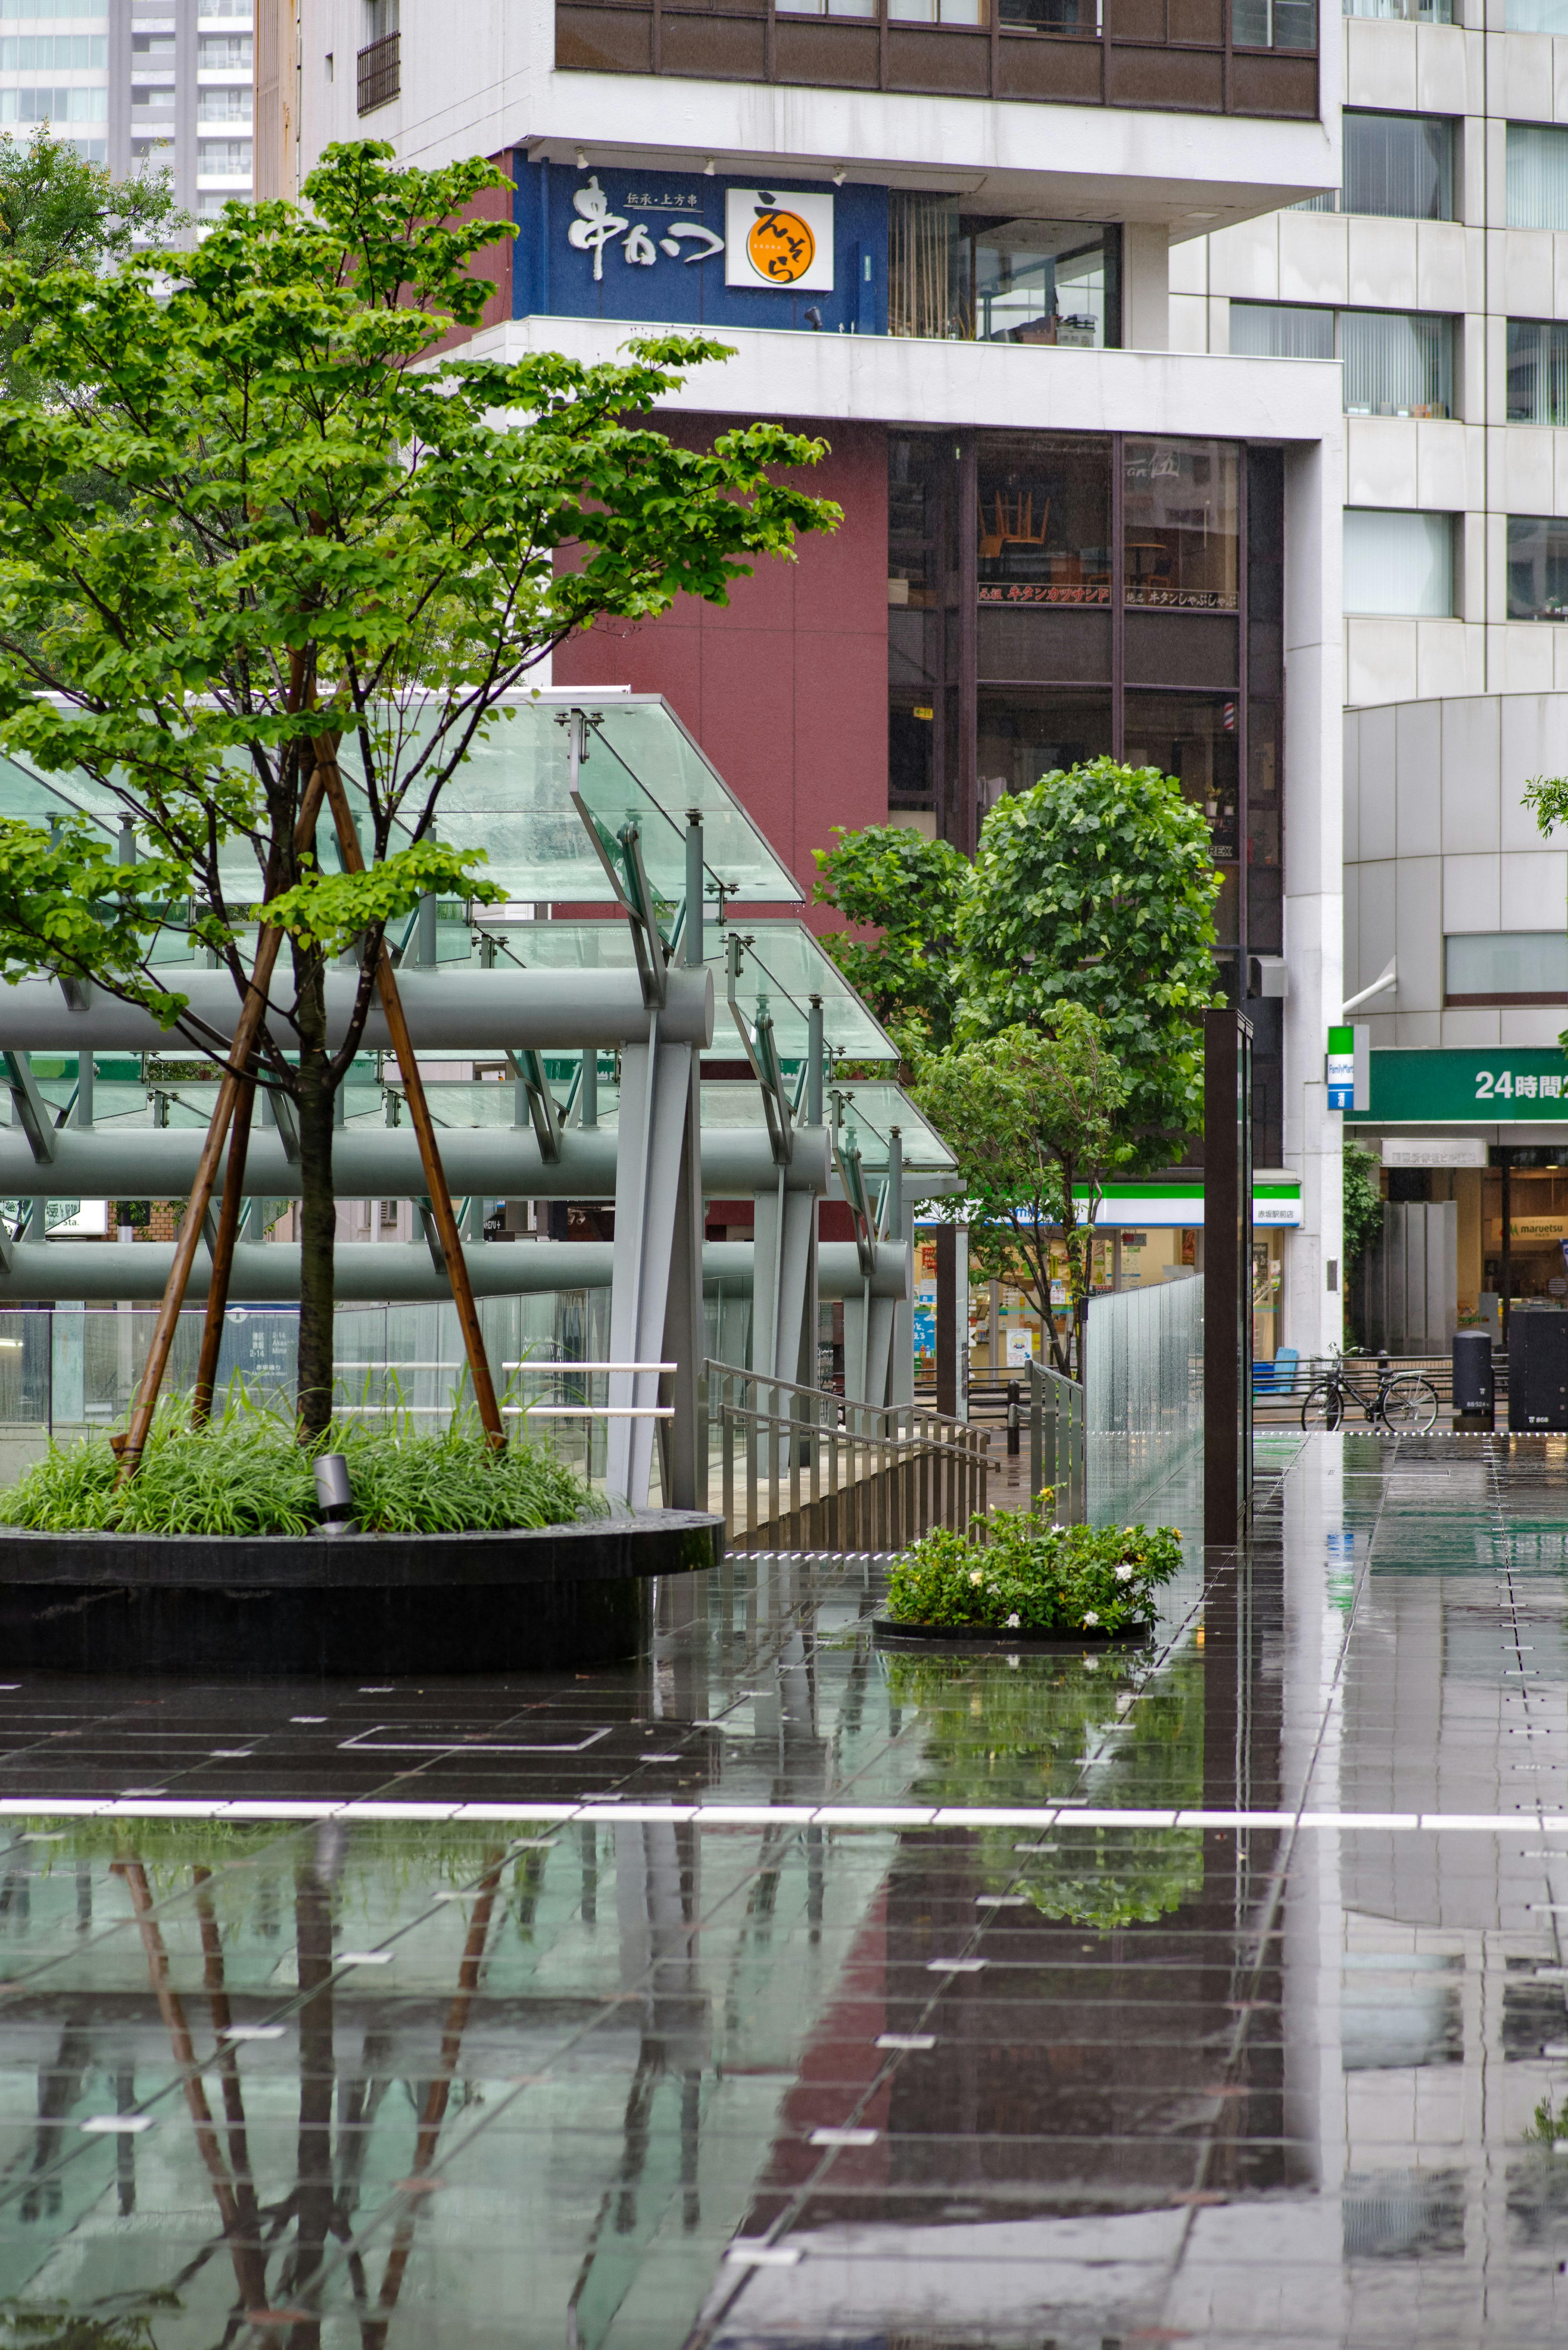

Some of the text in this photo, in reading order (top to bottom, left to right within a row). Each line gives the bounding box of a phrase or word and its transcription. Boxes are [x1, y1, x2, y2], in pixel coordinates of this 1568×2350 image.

[626, 192, 698, 207] 伝承・上方串
[568, 176, 725, 281] 串かつ
[979, 585, 1109, 603] 元祖 牛タンカツサンド
[1127, 591, 1236, 607] 絶品 牛タンしゃぶしゃぶ
[1205, 845, 1232, 857] REX
[1329, 1064, 1354, 1076] FamilyMart
[1475, 1071, 1568, 1099] 24時間
[1338, 1092, 1345, 1107] 酒
[1257, 1210, 1294, 1218] 赤坂駅前店
[1521, 1224, 1563, 1233] maruetsu
